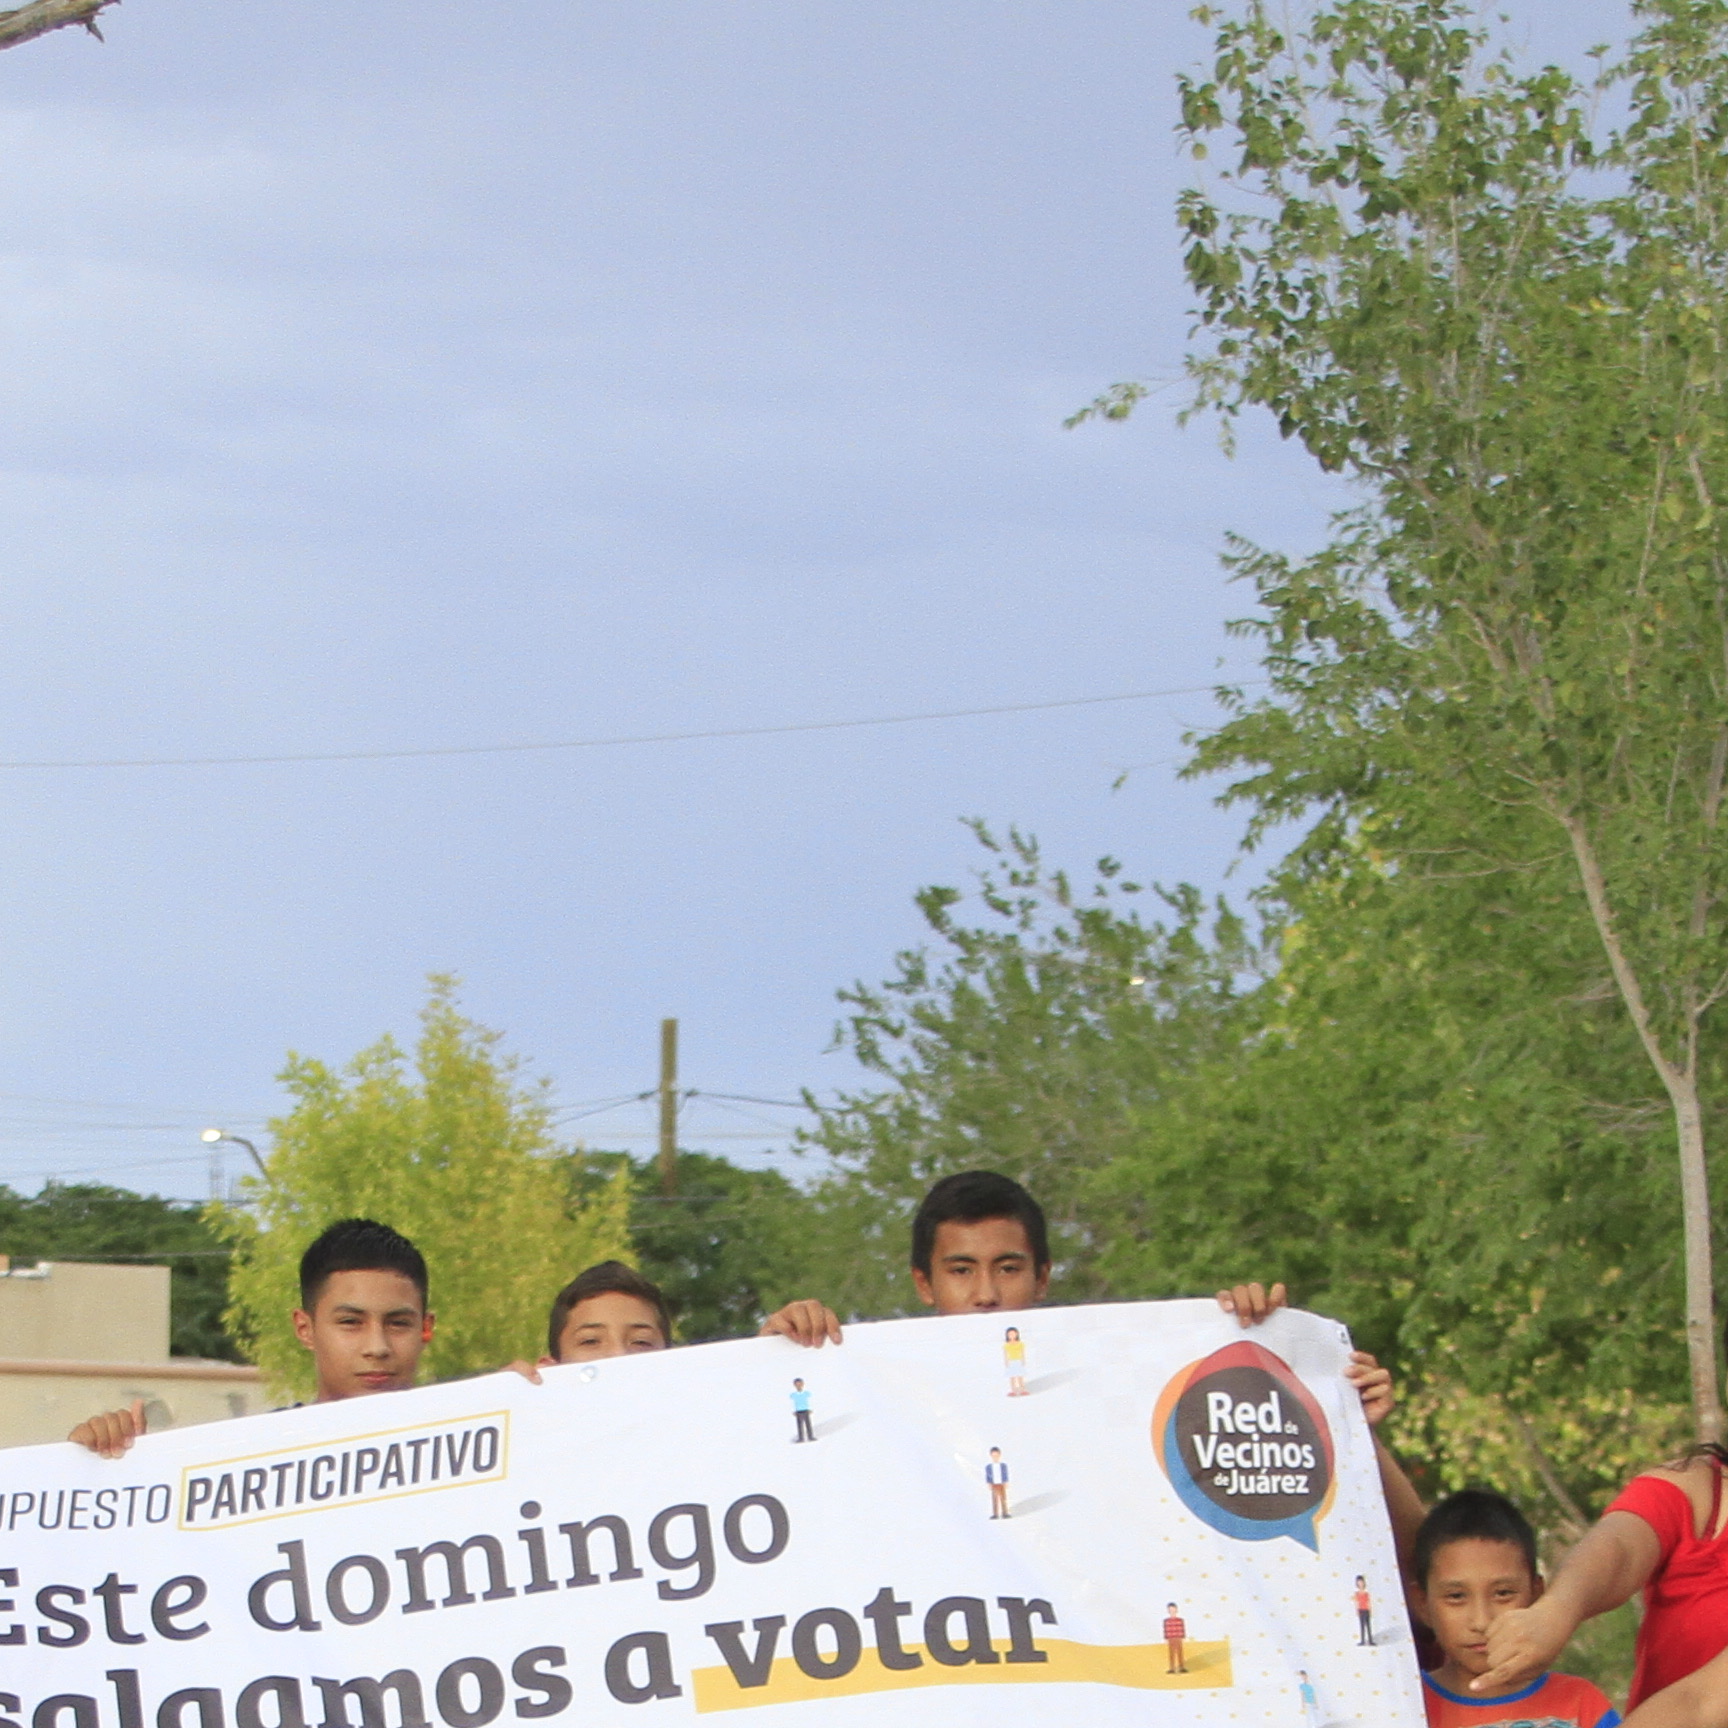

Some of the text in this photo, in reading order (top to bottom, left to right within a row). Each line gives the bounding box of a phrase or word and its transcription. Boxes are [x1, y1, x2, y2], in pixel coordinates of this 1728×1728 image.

[1207, 1390, 1299, 1435] Red de
[186, 1424, 501, 1521] PARTICIPATIVO
[1192, 1434, 1315, 1469] Vecinos
[1214, 1468, 1309, 1495] de Juárez
[248, 1491, 790, 1633] domingo
[605, 1630, 684, 1704] a
[704, 1586, 1058, 1689] votar
